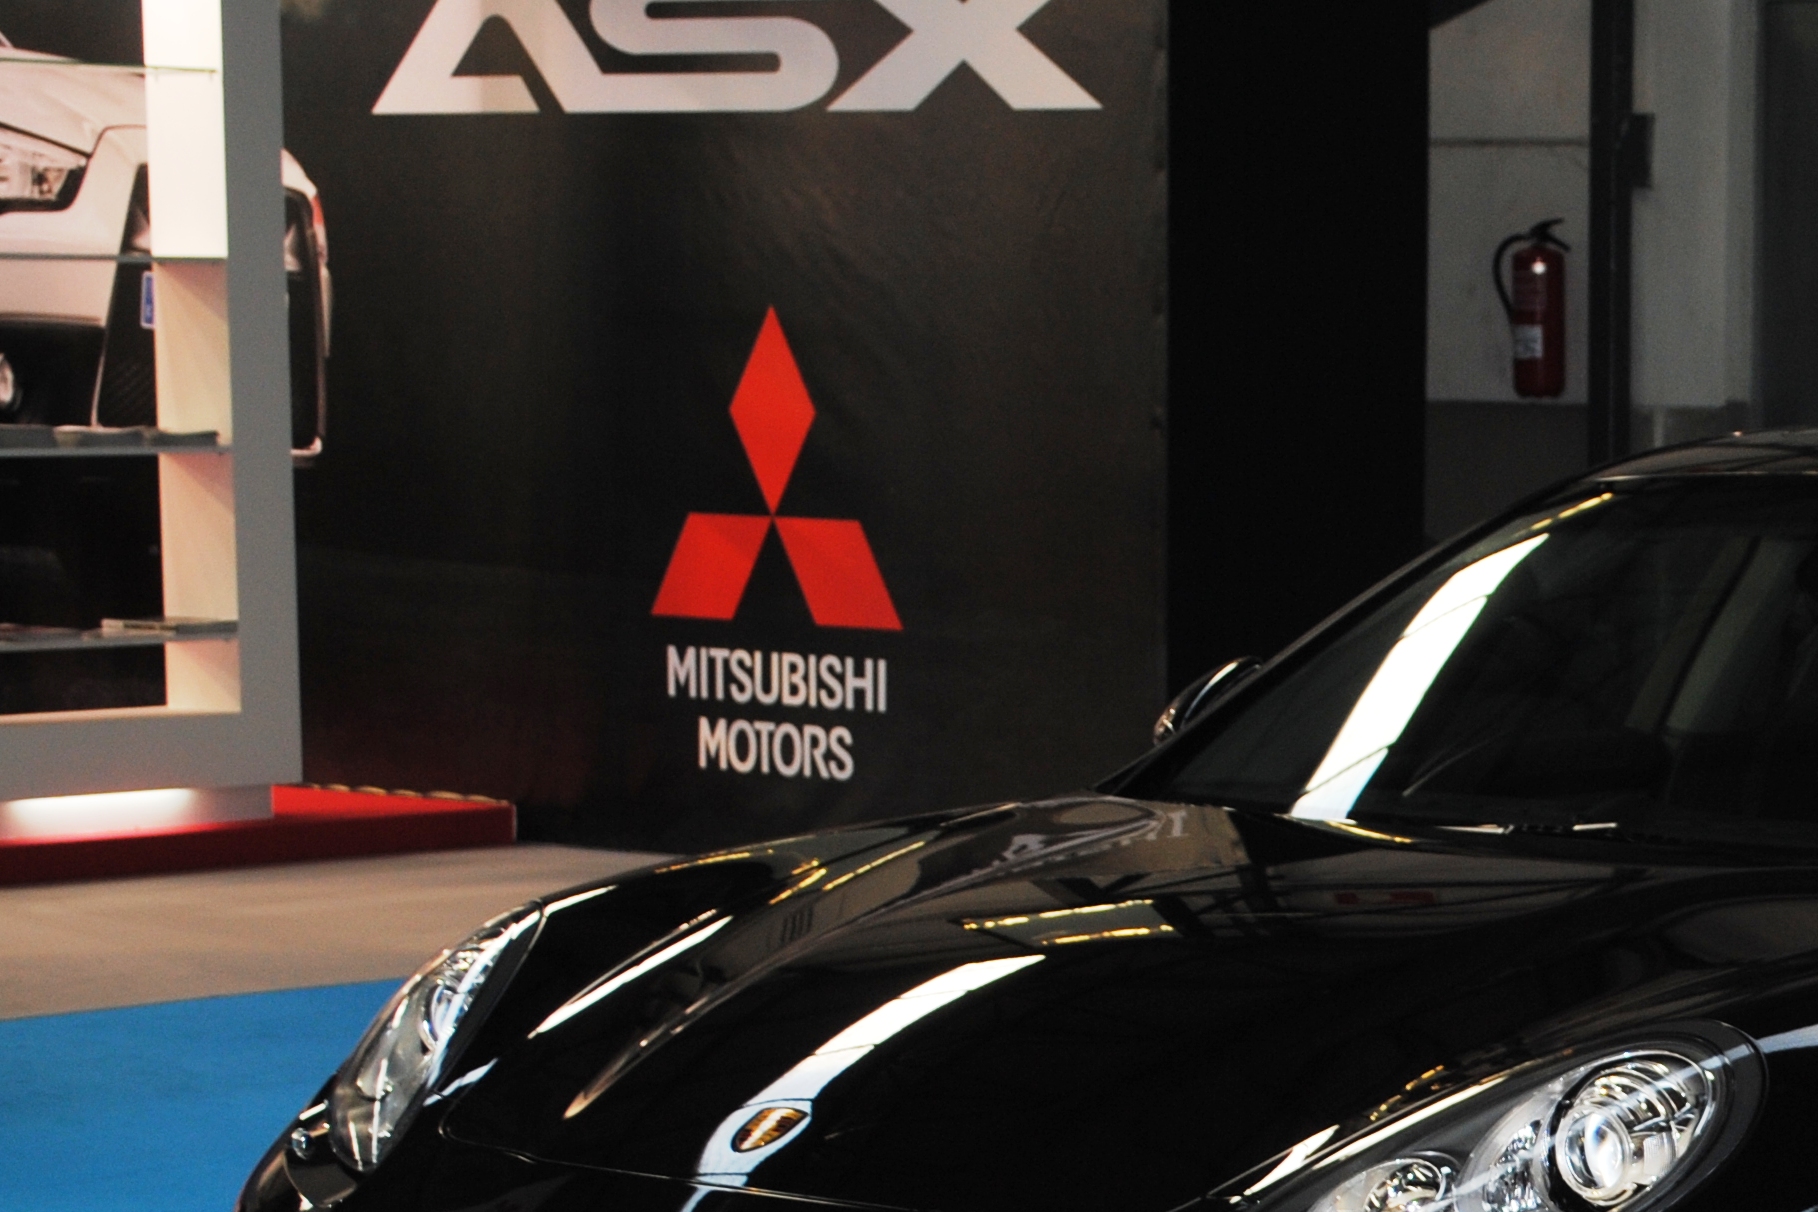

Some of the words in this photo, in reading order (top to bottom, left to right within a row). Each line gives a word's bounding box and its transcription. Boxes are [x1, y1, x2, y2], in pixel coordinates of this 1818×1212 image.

[371, 0, 1103, 114] ASX
[667, 644, 887, 714] MITSUBISHI
[698, 716, 854, 781] MOTORS
